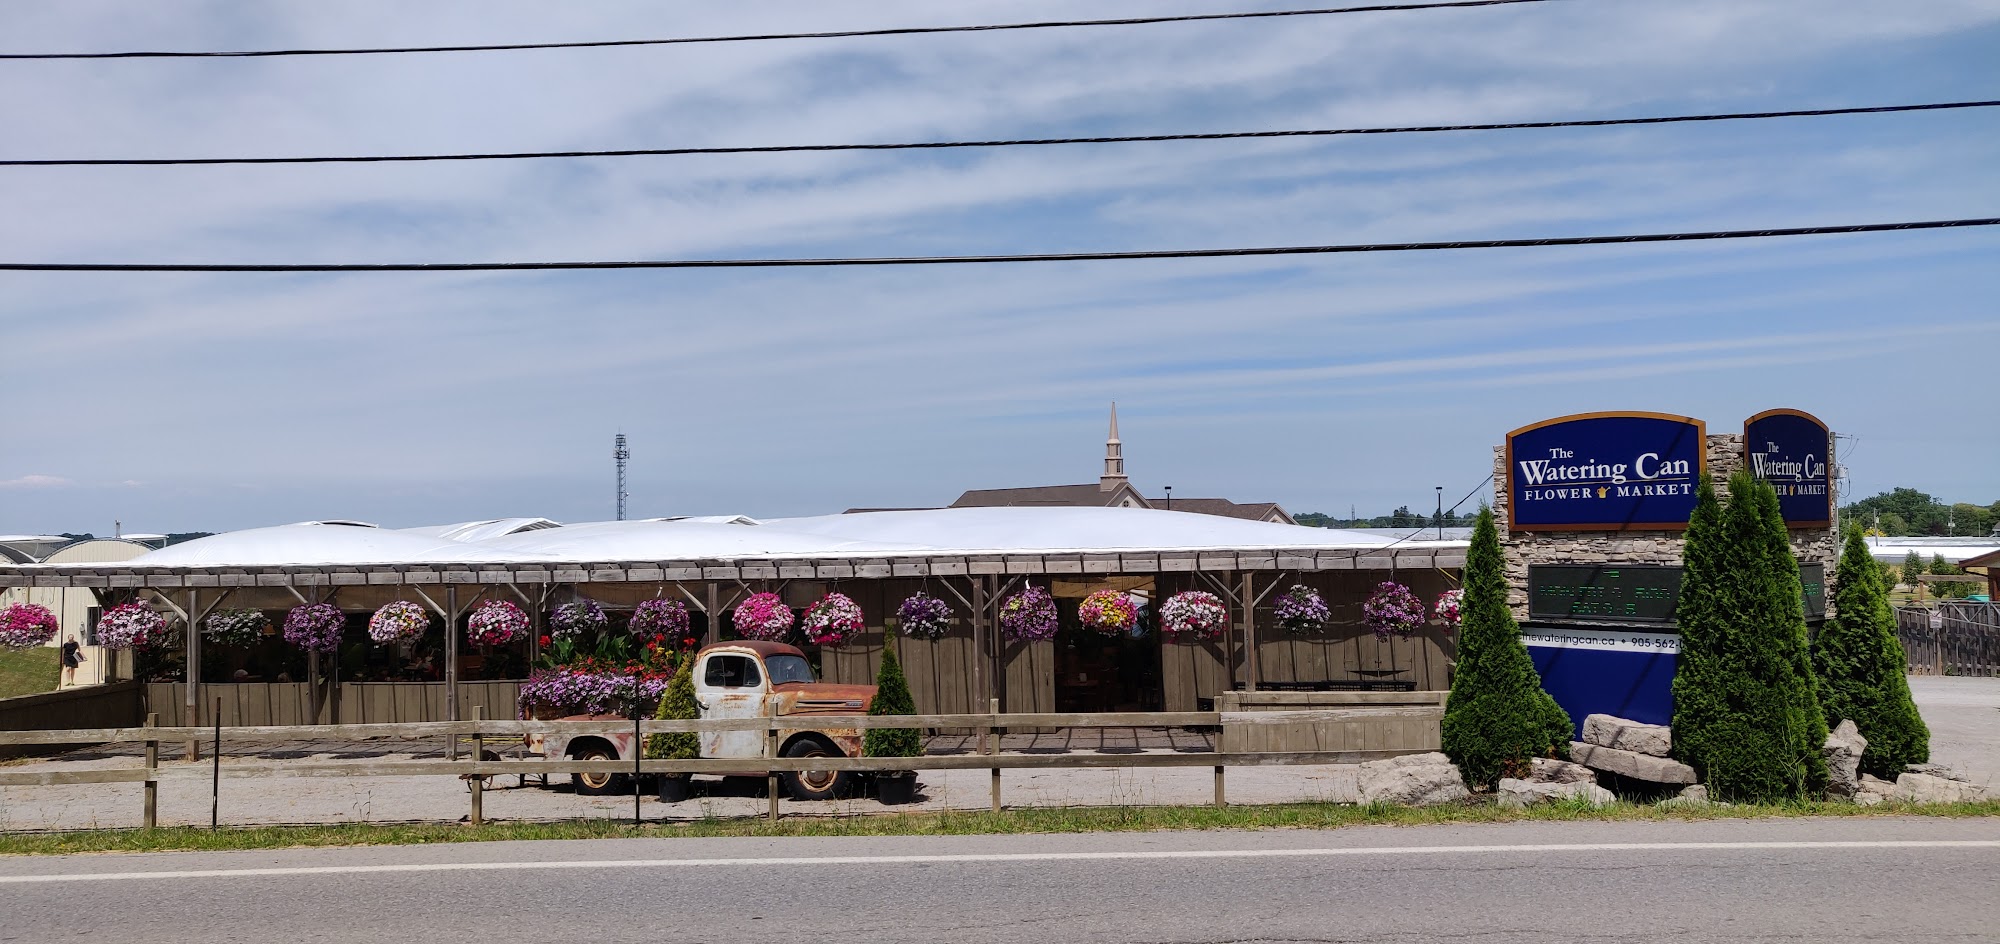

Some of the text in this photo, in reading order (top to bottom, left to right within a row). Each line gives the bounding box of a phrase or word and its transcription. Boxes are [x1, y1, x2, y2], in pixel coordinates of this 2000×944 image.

[1549, 448, 1574, 459] The
[1766, 441, 1780, 453] The
[1519, 452, 1691, 485] Watering Can
[1751, 452, 1825, 483] Watering Can
[1524, 483, 1692, 501] FLOWER MARKET
[1797, 484, 1826, 495] MARKET
